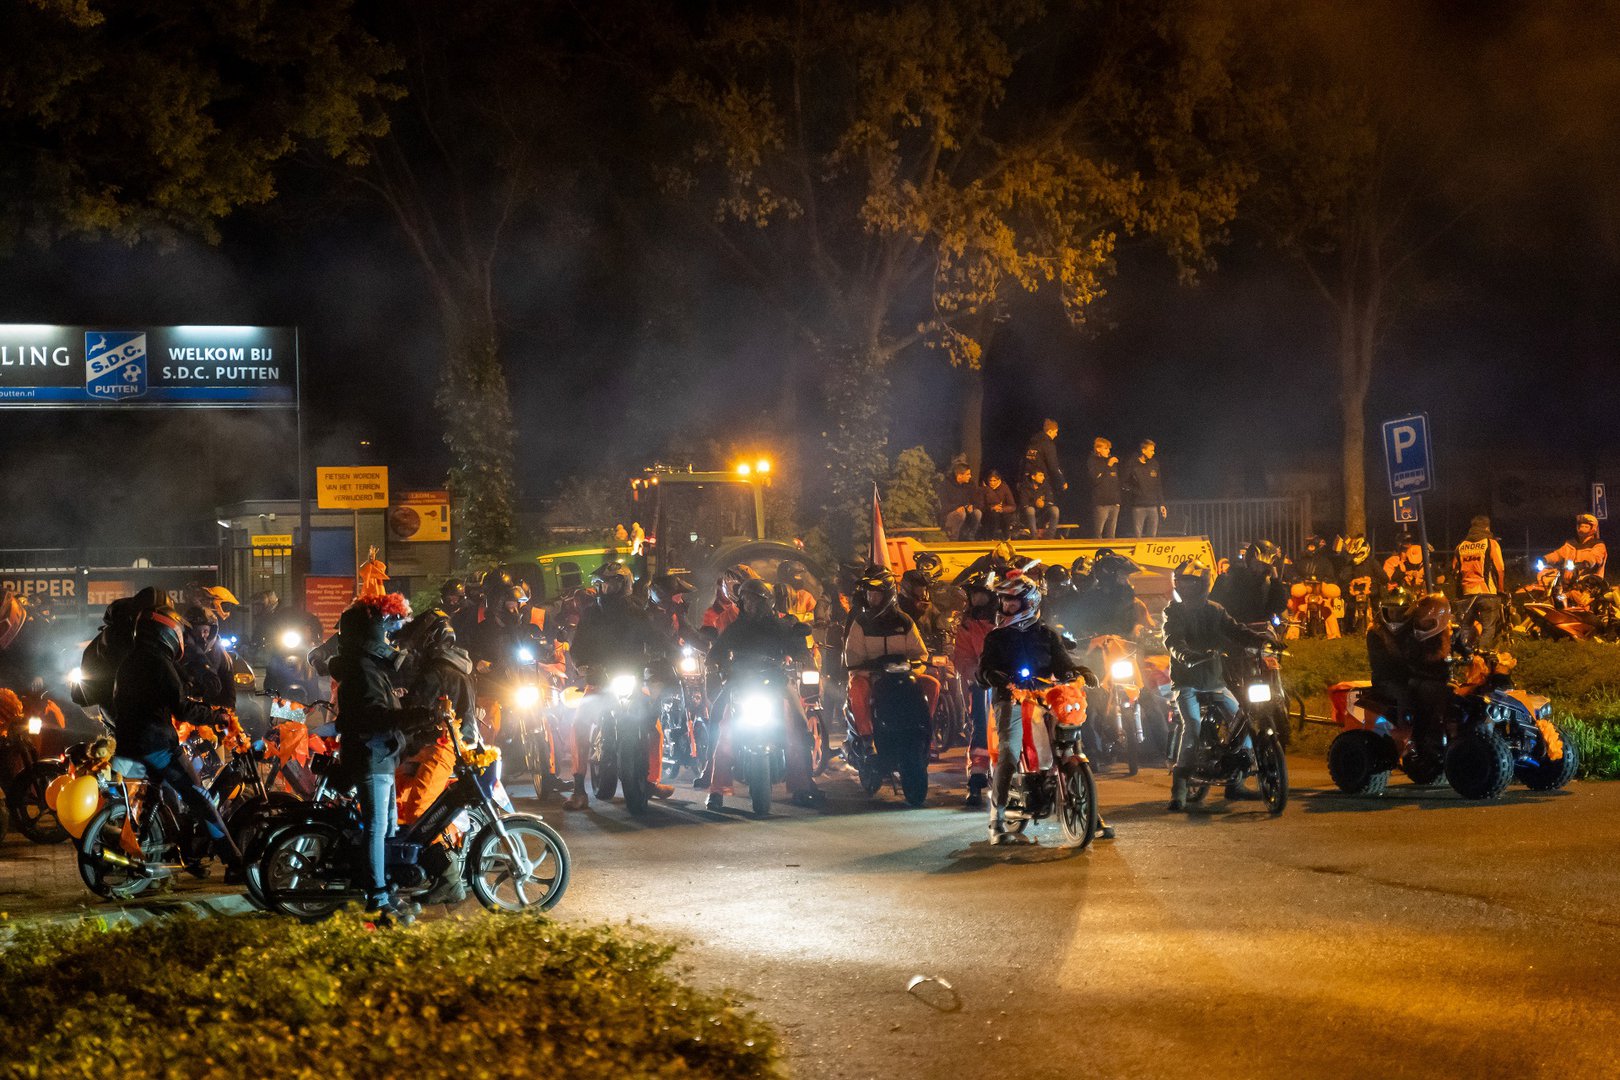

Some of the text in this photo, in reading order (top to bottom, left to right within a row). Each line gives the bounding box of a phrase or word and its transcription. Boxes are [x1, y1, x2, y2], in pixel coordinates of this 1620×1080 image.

[1, 345, 71, 367] LING
[90, 344, 142, 374] S.D.C.
[168, 347, 273, 361] WELKOM BIJ
[162, 366, 280, 379] S.D.C. PUTTEN
[95, 385, 138, 394] PUTTEN
[1393, 425, 1417, 464] P
[353, 472, 380, 480] WORDEN
[355, 483, 381, 491] TERREIN
[1595, 486, 1603, 504] P
[1146, 543, 1176, 555] Tiger
[1460, 543, 1486, 551] ANDRE
